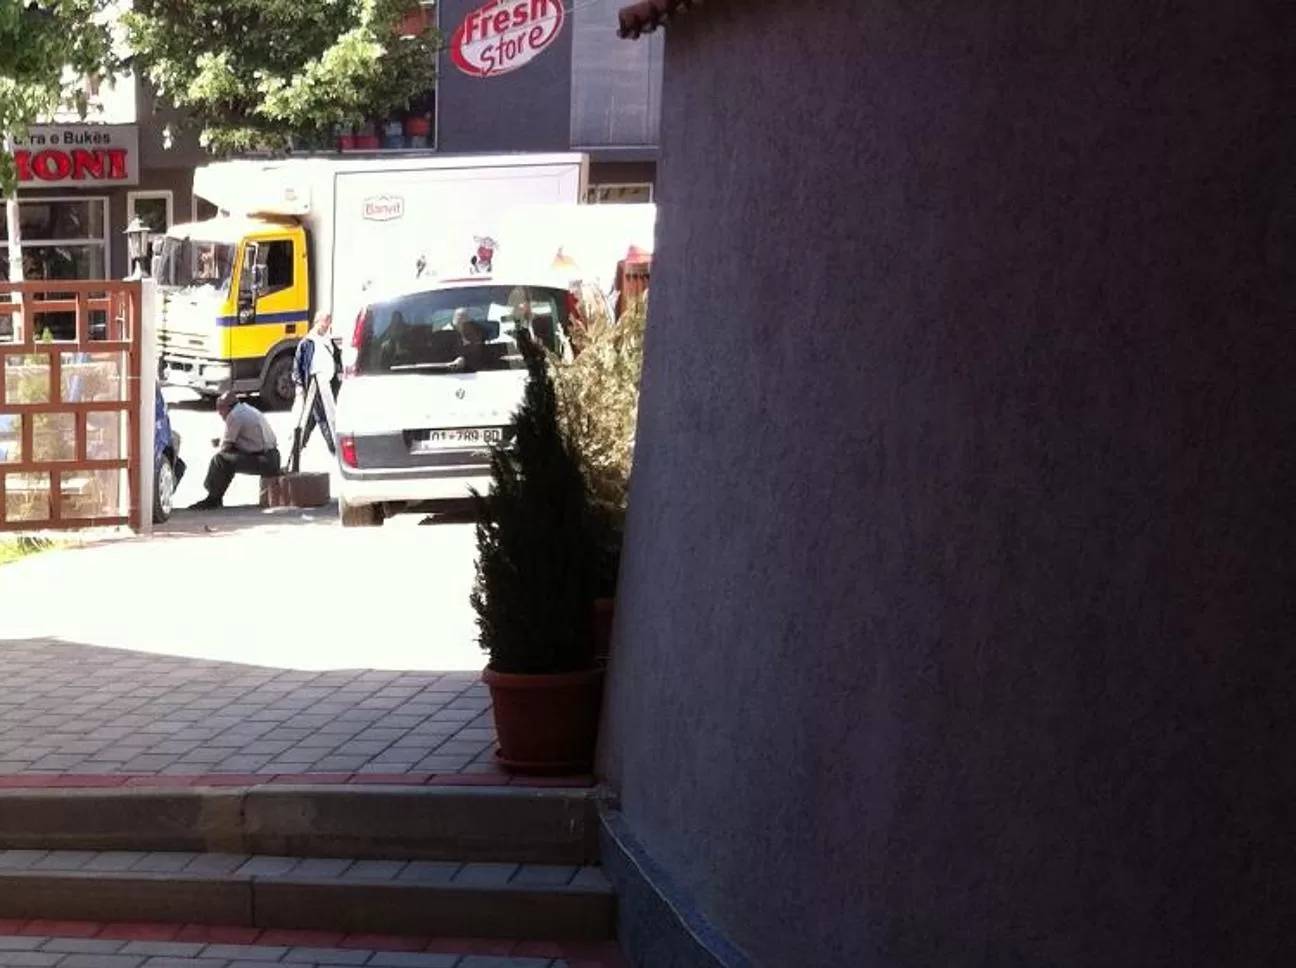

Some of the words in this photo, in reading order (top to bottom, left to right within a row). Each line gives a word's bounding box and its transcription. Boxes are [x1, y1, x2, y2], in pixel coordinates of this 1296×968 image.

[465, 0, 547, 45] Fresh
[480, 26, 544, 76] Store
[50, 135, 59, 145] e
